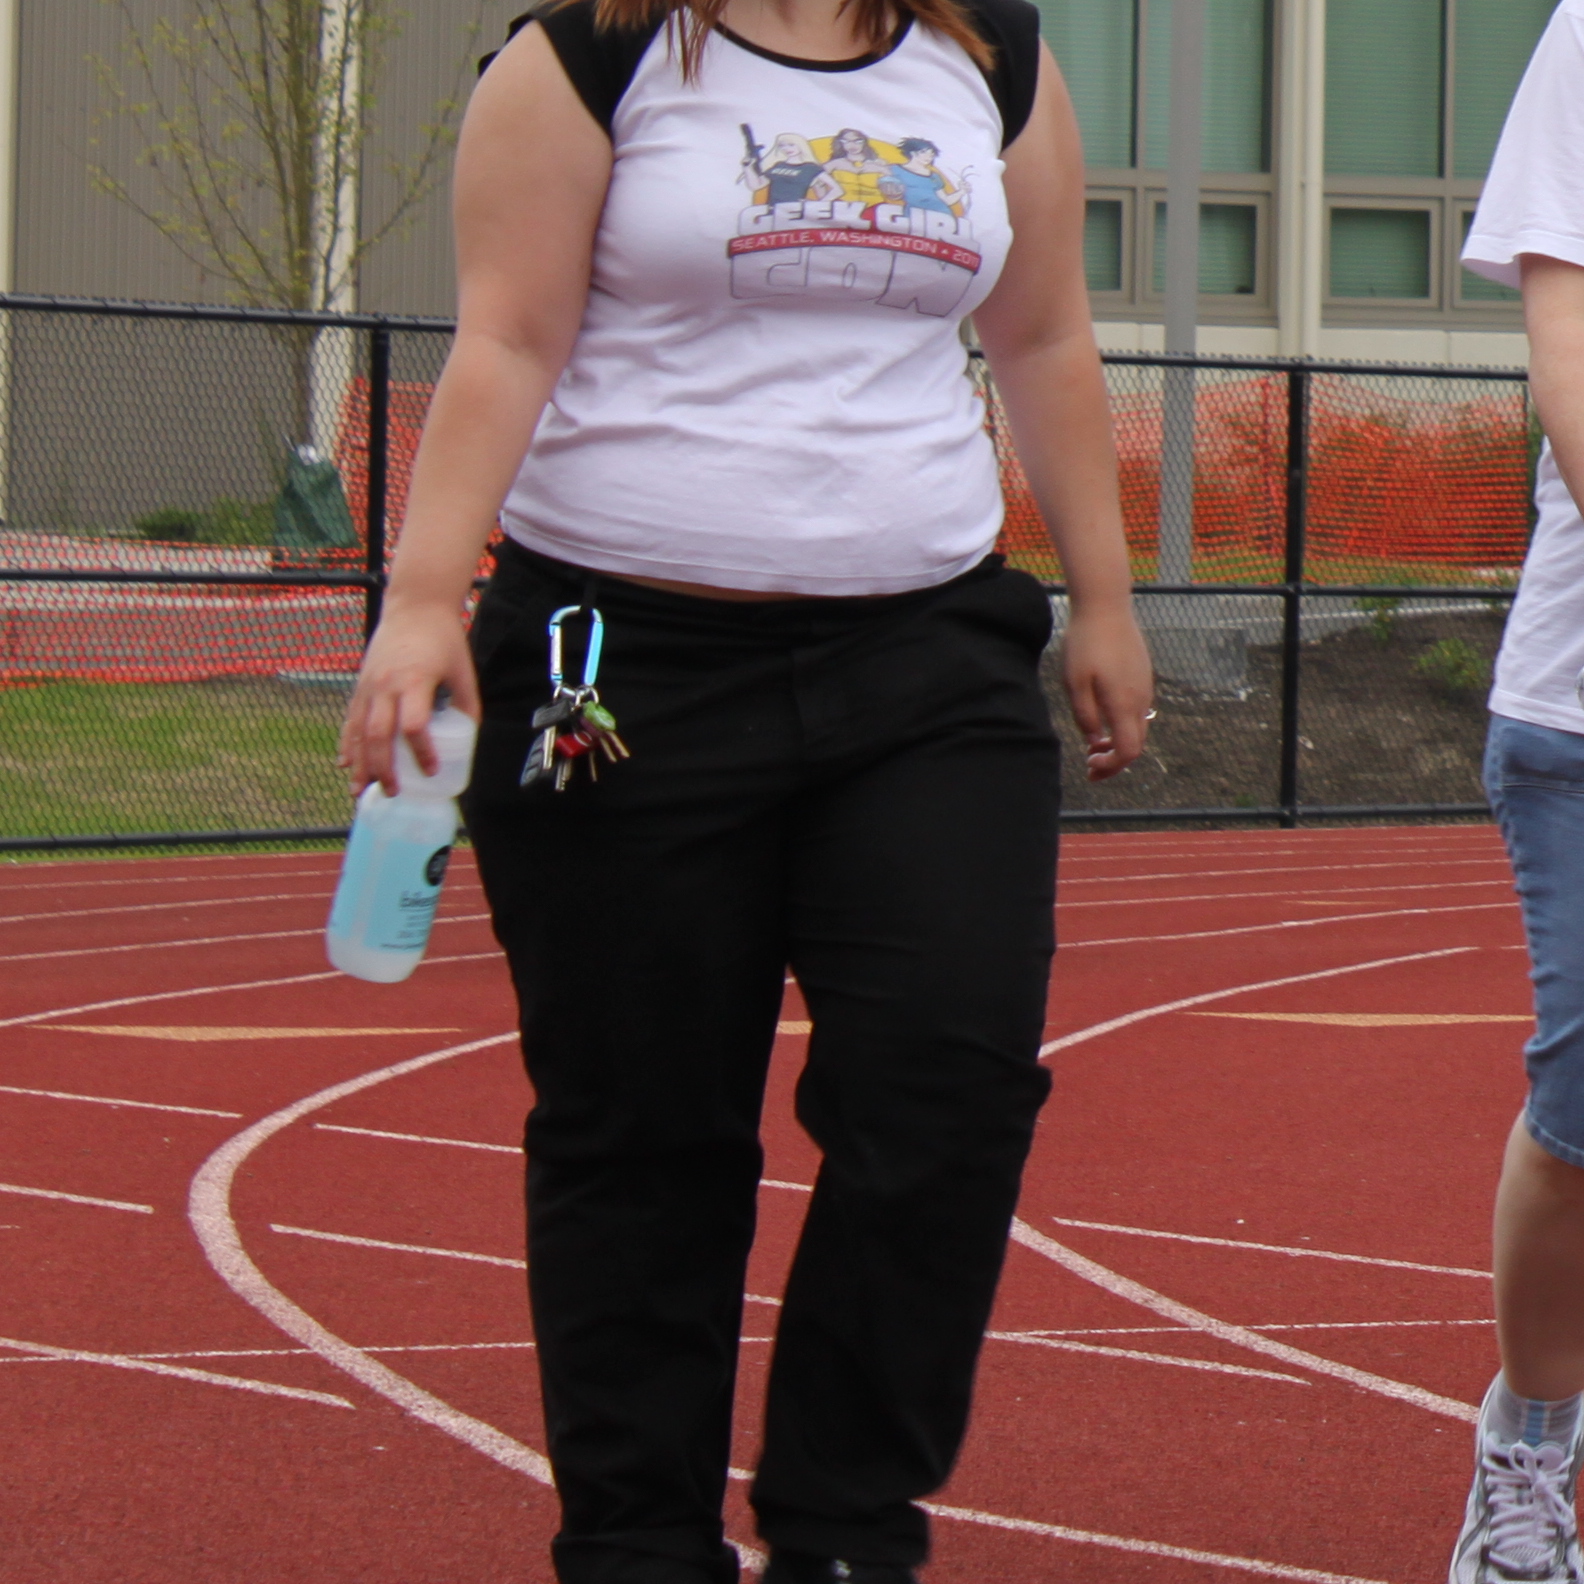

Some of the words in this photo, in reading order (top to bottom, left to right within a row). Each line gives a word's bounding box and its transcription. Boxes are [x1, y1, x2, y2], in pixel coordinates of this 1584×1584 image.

[738, 201, 872, 236] GEEK
[874, 202, 980, 249] GIRL
[819, 231, 938, 255] WASHINGTON
